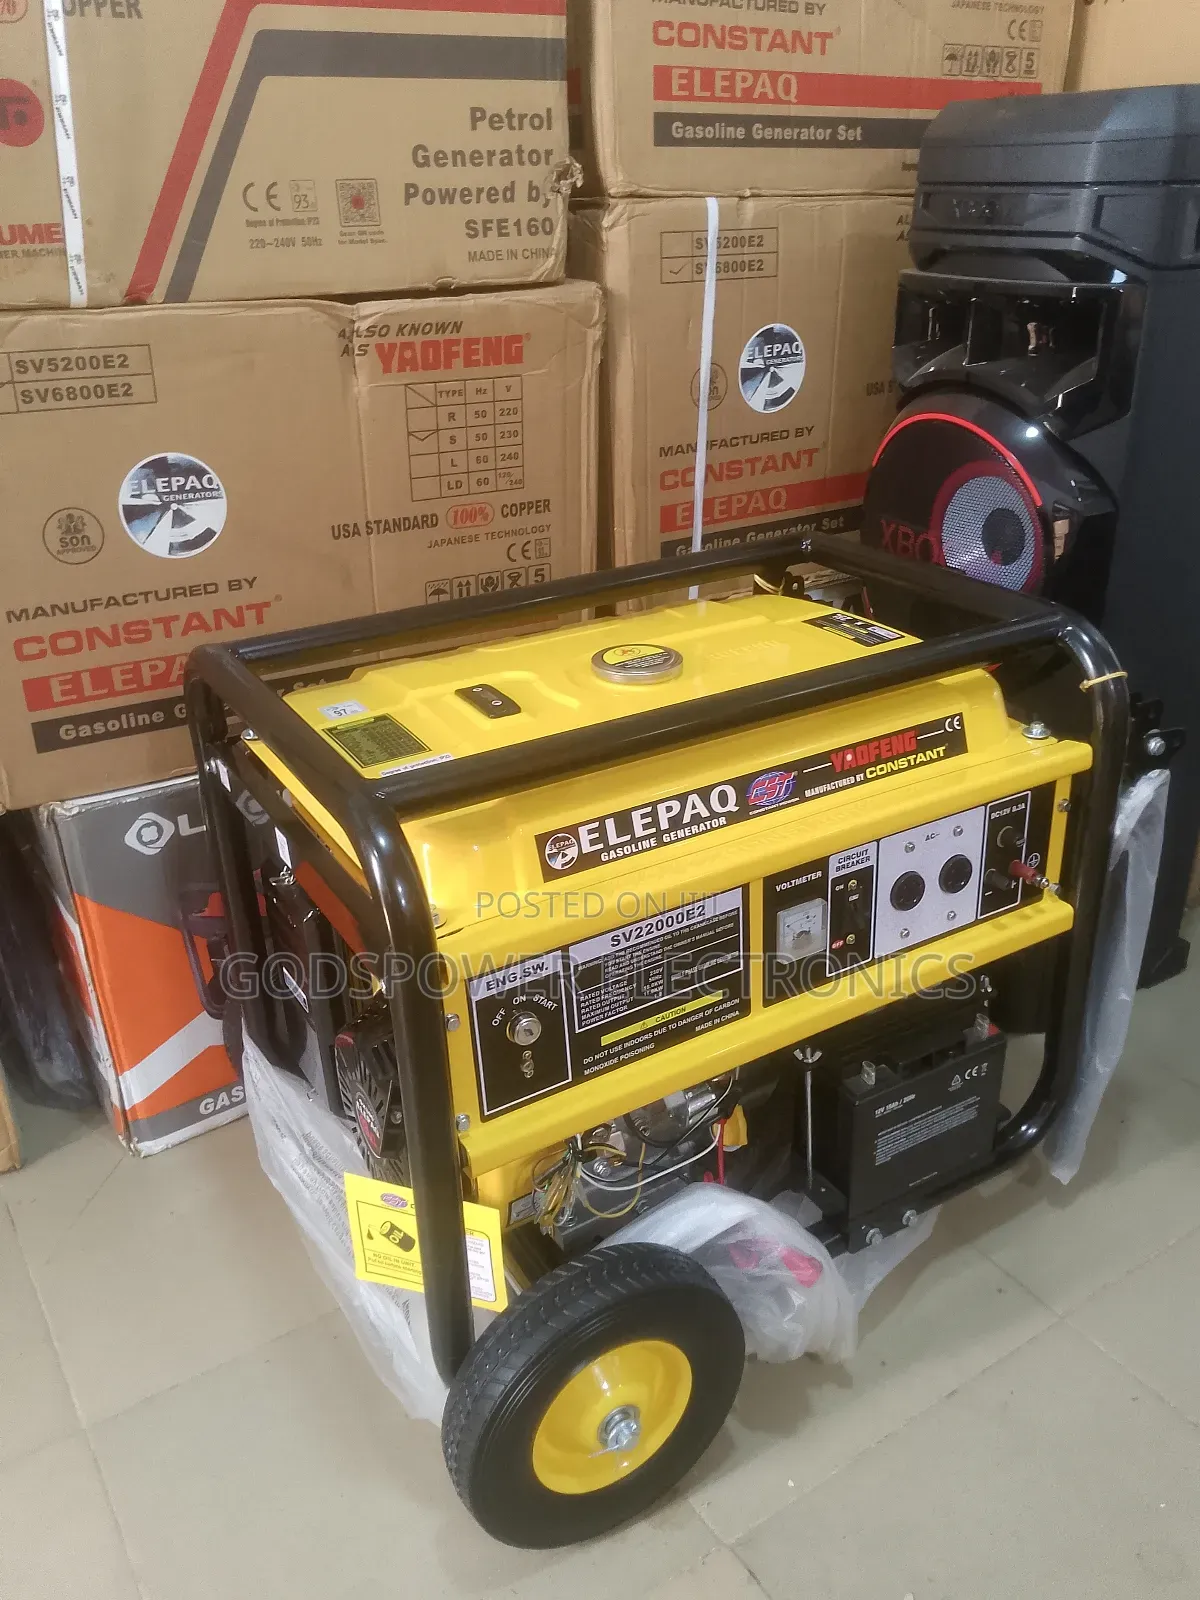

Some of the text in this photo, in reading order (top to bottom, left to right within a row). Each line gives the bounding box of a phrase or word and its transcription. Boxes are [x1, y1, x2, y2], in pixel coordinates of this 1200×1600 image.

[61, 0, 143, 19] OPPER
[804, 2, 827, 16] BY
[951, 1, 1045, 15] JAPANESE TECHNOLOGY
[652, 19, 834, 56] CONSTANT
[671, 67, 799, 103] ELEPAQ
[469, 106, 553, 131] Petrol
[671, 121, 863, 141] Gasoline Generator Set
[411, 143, 554, 168] Generator
[403, 180, 516, 206] Powered
[0, 222, 65, 246] UME
[464, 216, 554, 239] SFE160
[301, 236, 323, 247] 50Hz
[467, 250, 503, 263] MADE
[506, 248, 518, 260] IN
[338, 320, 464, 340] ALSO KNOWN
[340, 333, 525, 375] AS YAOFENG
[746, 341, 802, 360] ELEPAQ
[15, 353, 130, 376] SV5200E2
[20, 382, 134, 405] SV6800E2
[438, 385, 512, 399] TYPE Hz V
[447, 407, 519, 422] R 50 220
[449, 430, 519, 445] S 50 230
[658, 425, 815, 459] MANFACTURED BY
[450, 452, 520, 468] L 60 240
[659, 447, 820, 492] CONSTANT
[127, 474, 220, 495] ELEPAQ
[446, 477, 490, 491] LD 60
[676, 487, 787, 527] EEPAQ
[331, 498, 551, 541] USA STANDARD 100% COPPER
[821, 515, 844, 530] Set
[59, 534, 91, 549] son
[427, 523, 552, 550] JAPANESE TECHNOLOGY
[880, 518, 939, 563] XBO
[5, 576, 258, 624] MANUFACTURED BY
[13, 601, 272, 662] CONSTANT
[50, 660, 187, 703] ELEPA
[59, 710, 165, 741] Gasoline
[829, 730, 918, 773] YAOFENG
[804, 746, 946, 798] MANUFACTURED BY CONSTANT
[577, 784, 741, 855] ELEPAQ
[600, 816, 727, 862] GASOLINE GENERATOR
[835, 855, 871, 873] BREAKER
[837, 848, 869, 864] CIRCUIT
[775, 870, 823, 892] VOLTMETER
[835, 884, 845, 892] ON
[609, 904, 706, 948] SV22000E2
[485, 961, 549, 992] ENG.SW.
[512, 994, 527, 1005] ON
[579, 990, 599, 1002] RATED
[600, 979, 627, 994] VOLTAGE
[580, 996, 600, 1008] RATED
[532, 994, 559, 1012] START
[580, 992, 625, 1014] RATED OUTPUT
[581, 996, 633, 1020] MAXIMUM OUTPUT
[491, 1007, 507, 1027] OFF
[581, 1004, 628, 1027] POWER FACTOR
[655, 1006, 688, 1024] CAUTION
[695, 1010, 740, 1032] MADE IN CHINA
[583, 998, 740, 1065] DO NOT USE INDOORS DUE TO DANGER OF CARBON
[584, 1042, 656, 1076] MONOXIDE POISONING
[199, 1084, 247, 1116] GAS
